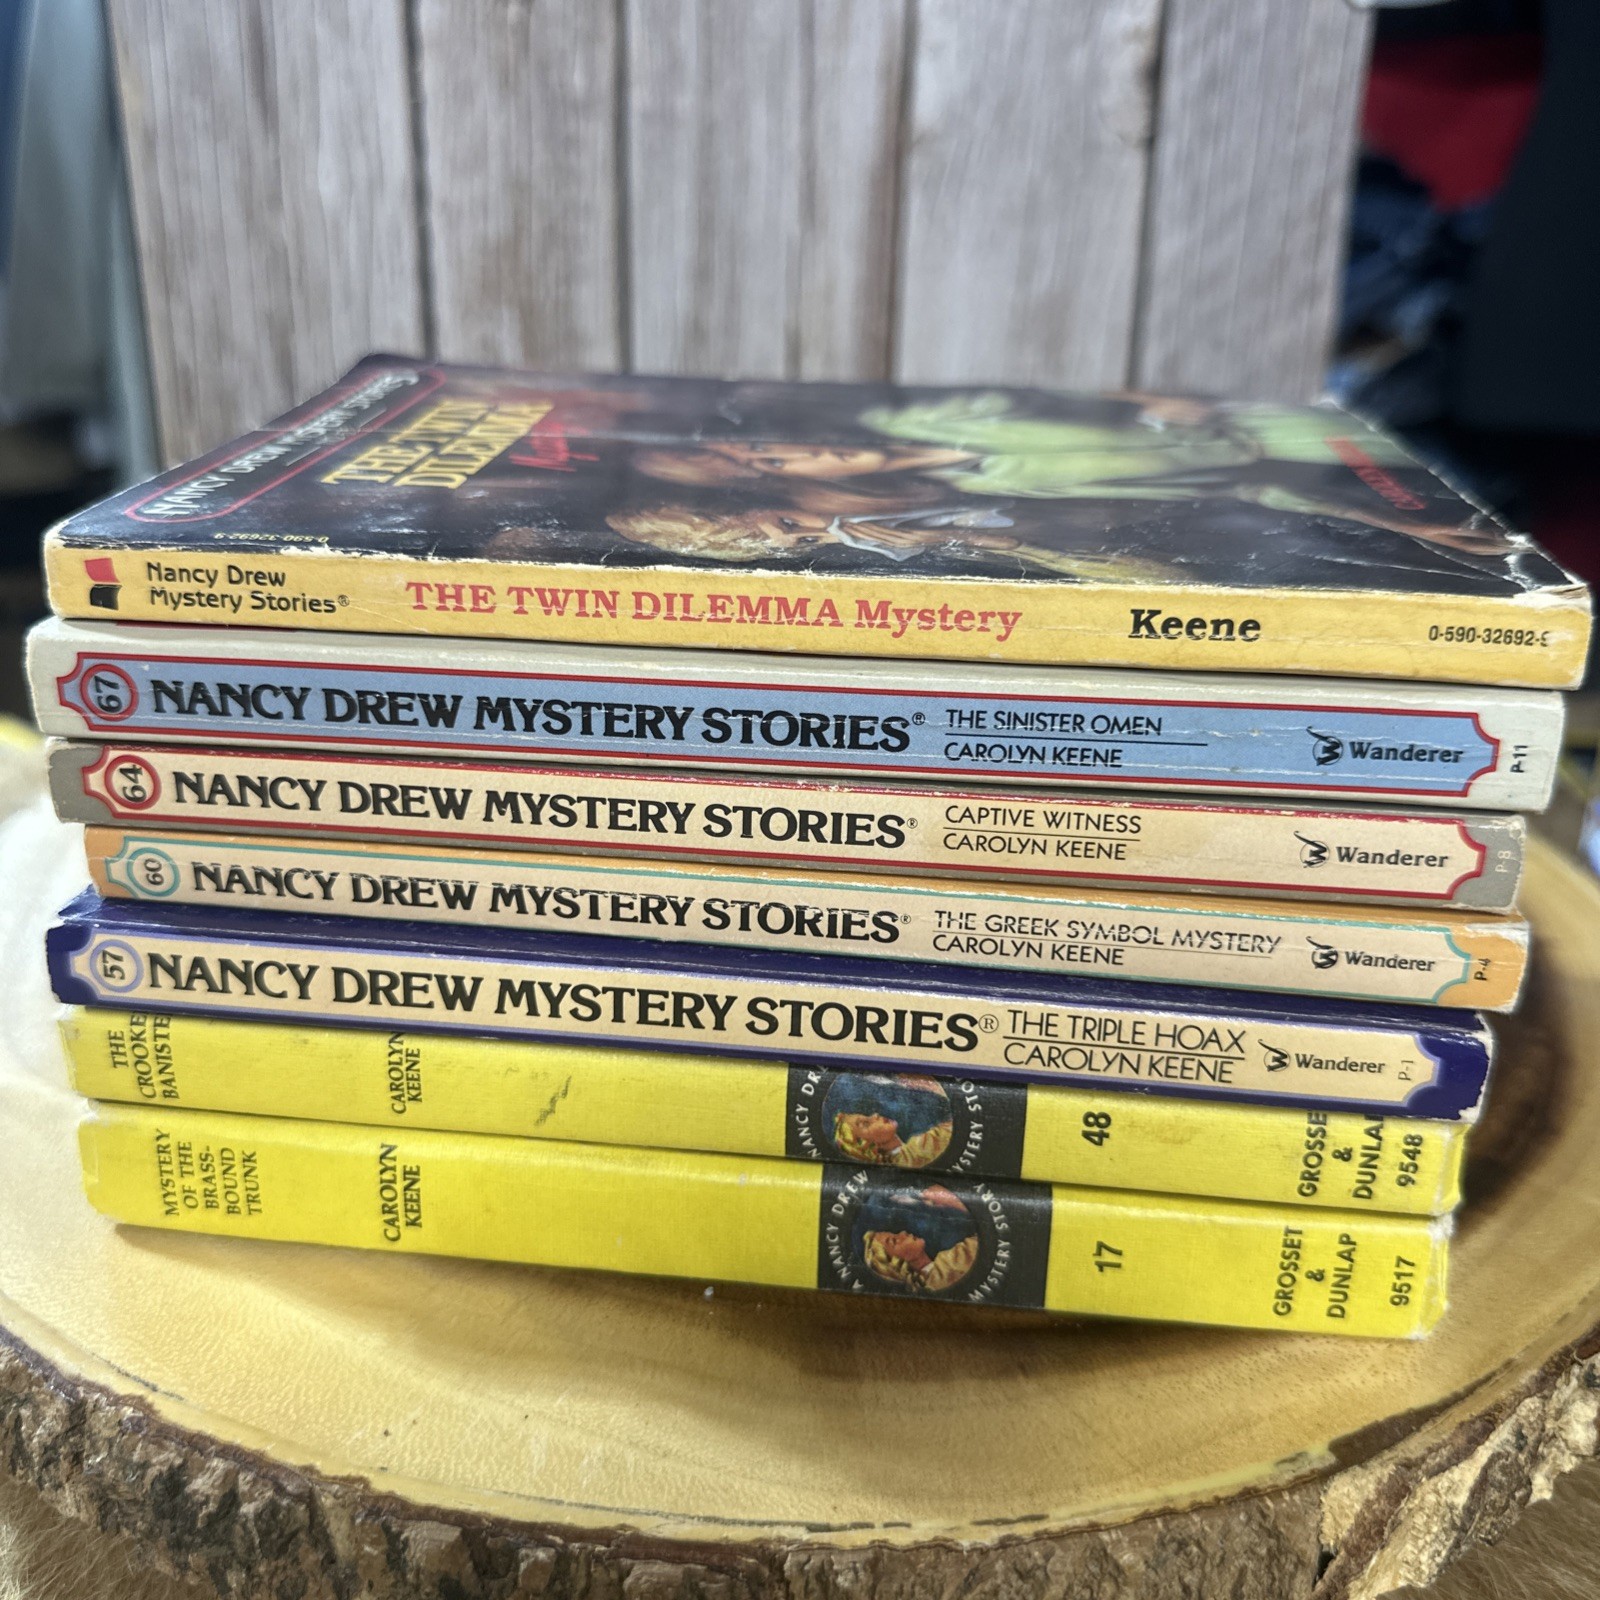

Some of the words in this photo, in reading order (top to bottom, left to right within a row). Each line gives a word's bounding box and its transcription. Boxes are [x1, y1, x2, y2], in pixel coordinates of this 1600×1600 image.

[320, 444, 435, 485] THE
[147, 561, 219, 586] Nancy
[229, 566, 286, 588] Drew
[150, 586, 246, 614] Mystery
[405, 581, 497, 614] THE
[507, 586, 620, 620] TWIN
[632, 591, 844, 628] DILEMMA
[854, 599, 1023, 642] Mystery
[1128, 608, 1262, 642] Keene
[96, 675, 120, 713] 67
[151, 679, 312, 721] NANCY
[322, 688, 468, 729] DREW
[474, 696, 697, 742] MYSTERY
[946, 709, 987, 730] THE
[993, 710, 1086, 733] SINISTER
[1091, 715, 1163, 737] OMEN
[944, 742, 1046, 765] CAROLYN
[1052, 748, 1124, 768] KEENE
[1349, 741, 1464, 763] Wanderer
[1510, 745, 1529, 773] P-11
[119, 765, 146, 803] 64
[173, 771, 328, 813] NANCY
[338, 781, 473, 822] DREW
[482, 789, 697, 834] MYSTERY
[945, 805, 1035, 828] CAPTIVE
[1043, 810, 1142, 834] WITNESS
[943, 833, 1047, 856] CAROLYN
[1055, 839, 1127, 861] KEENE
[1336, 846, 1449, 868] Wanderer
[1495, 851, 1511, 873] P-8
[145, 858, 164, 887] 60
[191, 861, 339, 901] NANCY
[350, 873, 478, 911] DREW
[490, 882, 695, 927] MYSTERY
[933, 934, 1043, 959] CAROLYN
[1051, 944, 1125, 966] KEENE
[934, 910, 977, 931] THE
[984, 913, 1060, 938] GREEK
[1066, 920, 1165, 946] SYMBOL
[1170, 928, 1282, 955] MYSTERY
[102, 950, 125, 981] 57
[1345, 951, 1435, 973] Wanderer
[1473, 957, 1490, 981] P-4
[147, 953, 319, 1001] NANCY
[333, 967, 483, 1011] DREW
[495, 978, 738, 1031] MYSTERY
[108, 1030, 129, 1068] THE
[1007, 1009, 1059, 1038] THE
[1067, 1015, 1146, 1046] TRIPLE
[1154, 1023, 1247, 1054] HOAX
[130, 1012, 157, 1099] CROOKE
[153, 1014, 180, 1100] BANISTE
[388, 1032, 407, 1114] CAROLYN
[405, 1047, 422, 1103] KEENE
[1003, 1042, 1142, 1075] CAROLYN
[1147, 1055, 1234, 1084] KEENE
[1295, 1053, 1386, 1074] Wanderer
[1398, 1060, 1414, 1081] P-1
[795, 1103, 821, 1158] NANCY
[946, 1121, 983, 1173] YSTERY
[1081, 1111, 1112, 1146] 48
[156, 1127, 180, 1216] MYSTERY
[178, 1141, 195, 1178] THE
[1297, 1111, 1327, 1197] GROSSE
[1332, 1147, 1353, 1162] &
[1352, 1113, 1384, 1200] DUNLA
[1396, 1133, 1423, 1187] 9548
[182, 1184, 199, 1209] OF
[199, 1145, 220, 1209] BRASS-
[220, 1147, 242, 1215] BOUND
[241, 1150, 262, 1215] TRUNK
[379, 1142, 401, 1242] CAROLYN
[403, 1164, 422, 1228] KEENE
[831, 1169, 869, 1216] DREW
[973, 1182, 1010, 1231] STORY
[826, 1222, 852, 1279] NANCY
[967, 1239, 1011, 1302] MYSTERY
[1093, 1240, 1123, 1273] 17
[1272, 1225, 1303, 1317] GROSSET
[1304, 1268, 1326, 1282] &
[1326, 1232, 1357, 1319] DUNLAP
[1389, 1255, 1416, 1306] 9517
